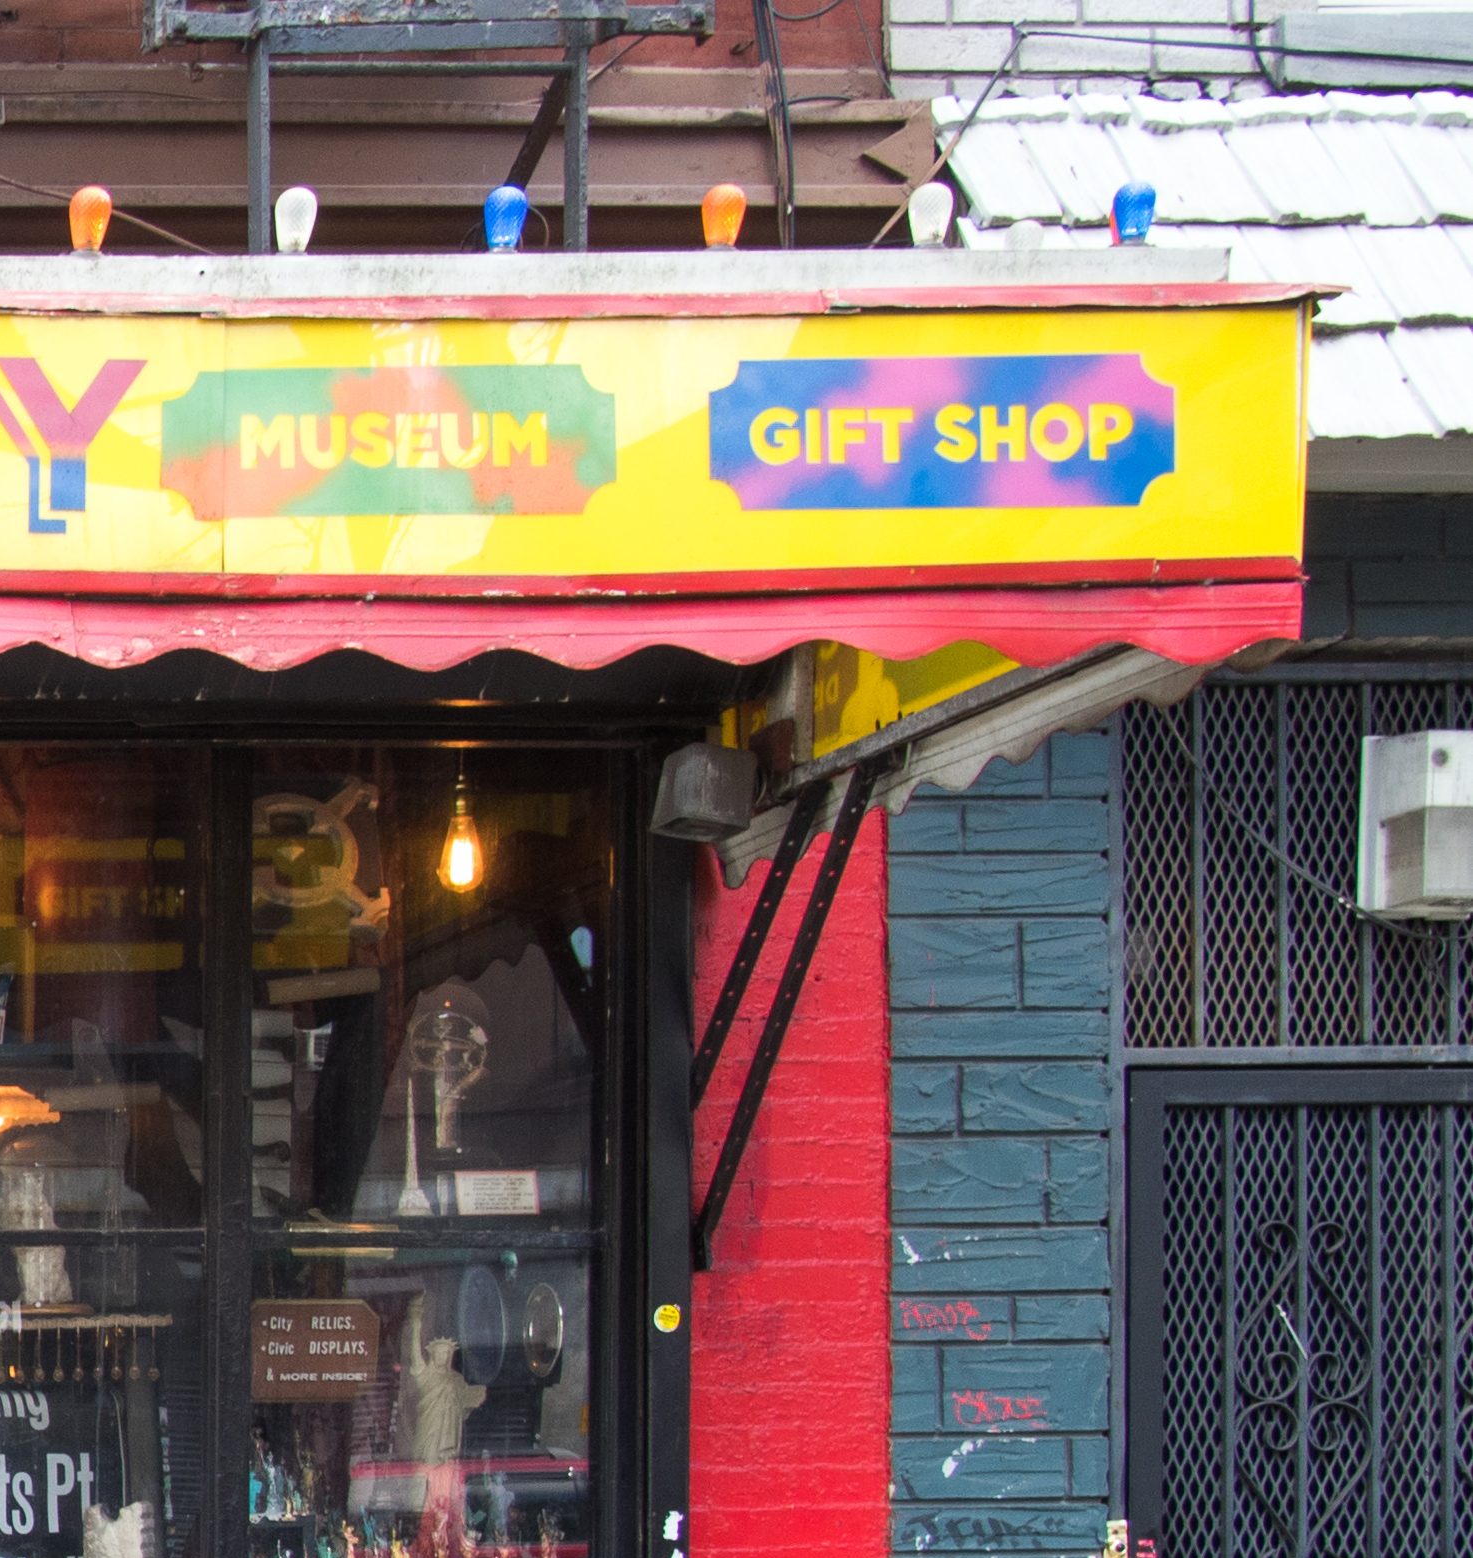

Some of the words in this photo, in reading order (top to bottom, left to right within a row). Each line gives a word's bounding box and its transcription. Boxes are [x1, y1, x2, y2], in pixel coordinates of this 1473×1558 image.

[238, 410, 549, 472] MUSEUM
[748, 405, 915, 466] GIFT
[933, 402, 1135, 464] SHOP
[270, 1316, 293, 1332] City
[311, 1316, 356, 1331] RELICS,
[268, 1342, 295, 1355] Civic
[309, 1341, 368, 1356] DISPLAYS,
[280, 1373, 318, 1382] MORE
